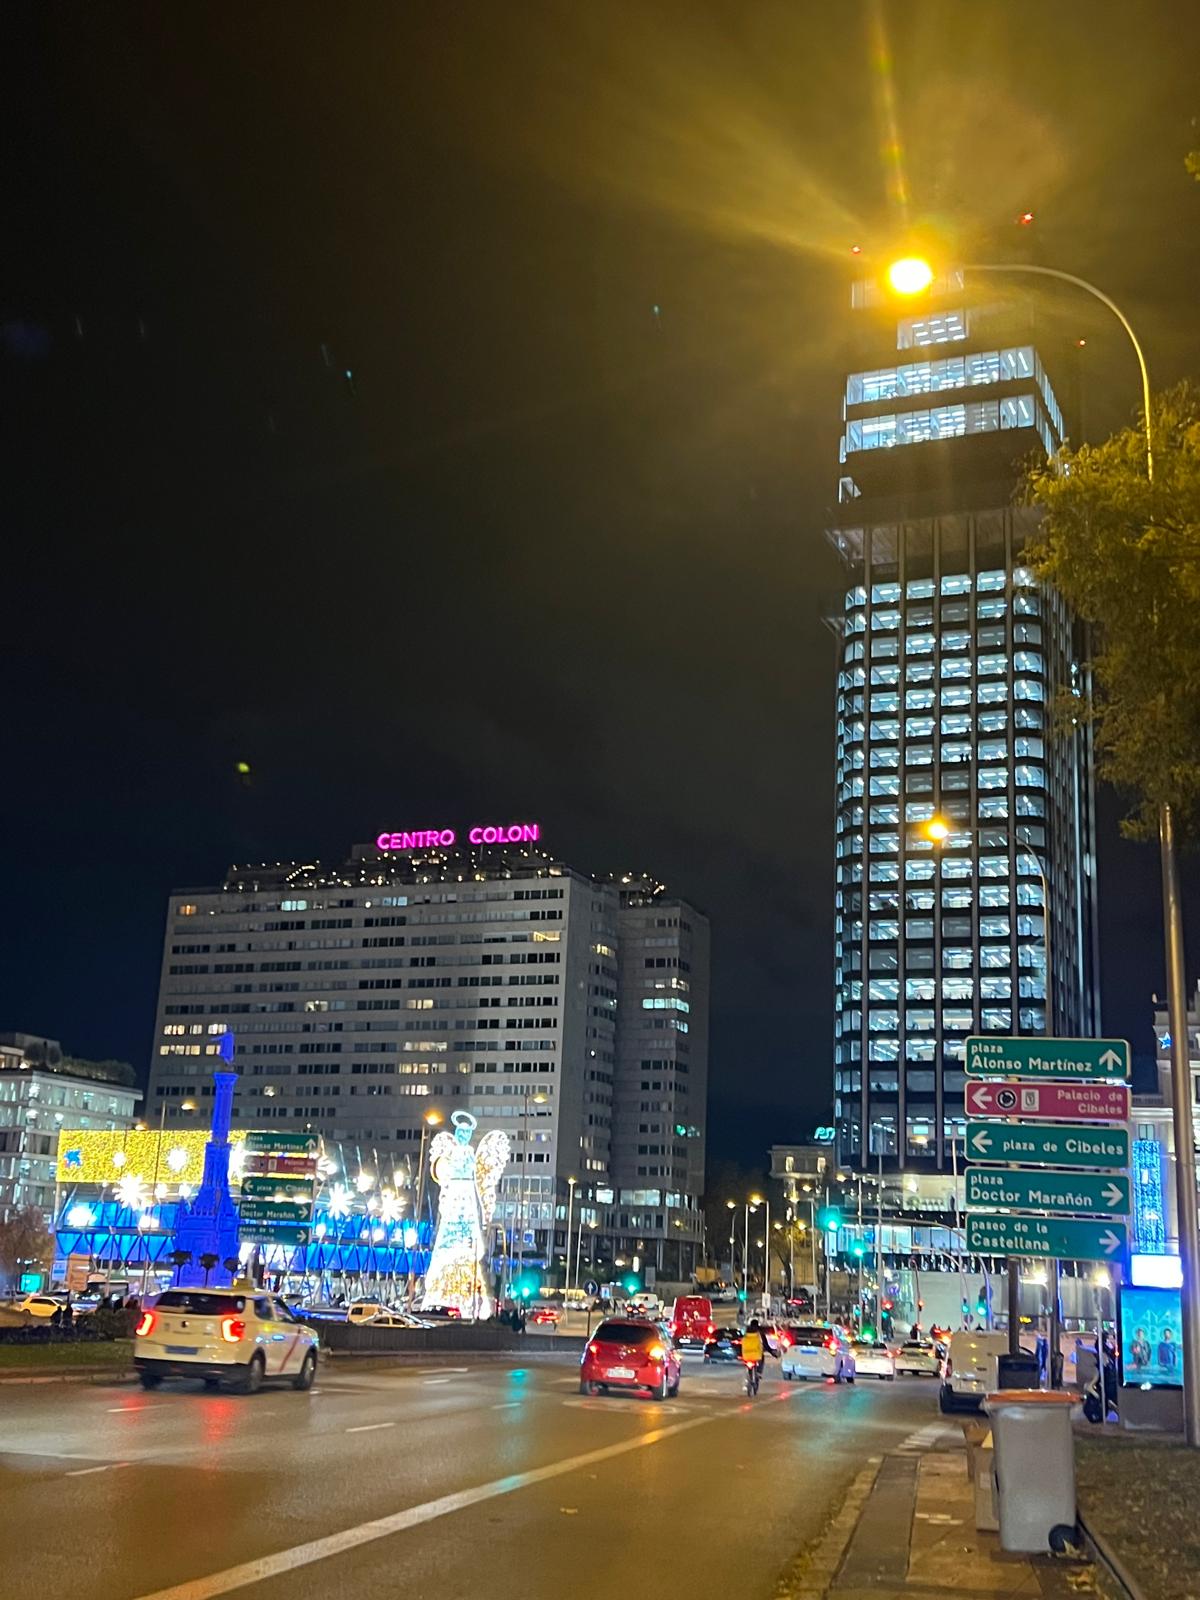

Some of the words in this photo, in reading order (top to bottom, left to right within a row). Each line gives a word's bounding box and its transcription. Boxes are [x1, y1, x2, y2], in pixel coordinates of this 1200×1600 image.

[377, 829, 455, 850] CENTRO
[469, 824, 539, 845] COLON
[971, 1043, 1003, 1055] plaza
[971, 1055, 1022, 1069] Alonso
[1028, 1057, 1092, 1072] Martínez
[1057, 1089, 1101, 1101] Palacio
[1108, 1092, 1122, 1102] de
[1078, 1103, 1122, 1114] Cibeles
[1003, 1139, 1036, 1153] plaza
[1043, 1141, 1058, 1152] de
[1065, 1139, 1124, 1155] Cibeles
[970, 1174, 1003, 1186] plaza
[970, 1187, 1021, 1202] Doctor
[1028, 1189, 1093, 1206] Marañón
[971, 1221, 1006, 1232] paseo
[1014, 1222, 1029, 1233] de
[1036, 1222, 1048, 1234] la
[971, 1233, 1050, 1251] Castellana
